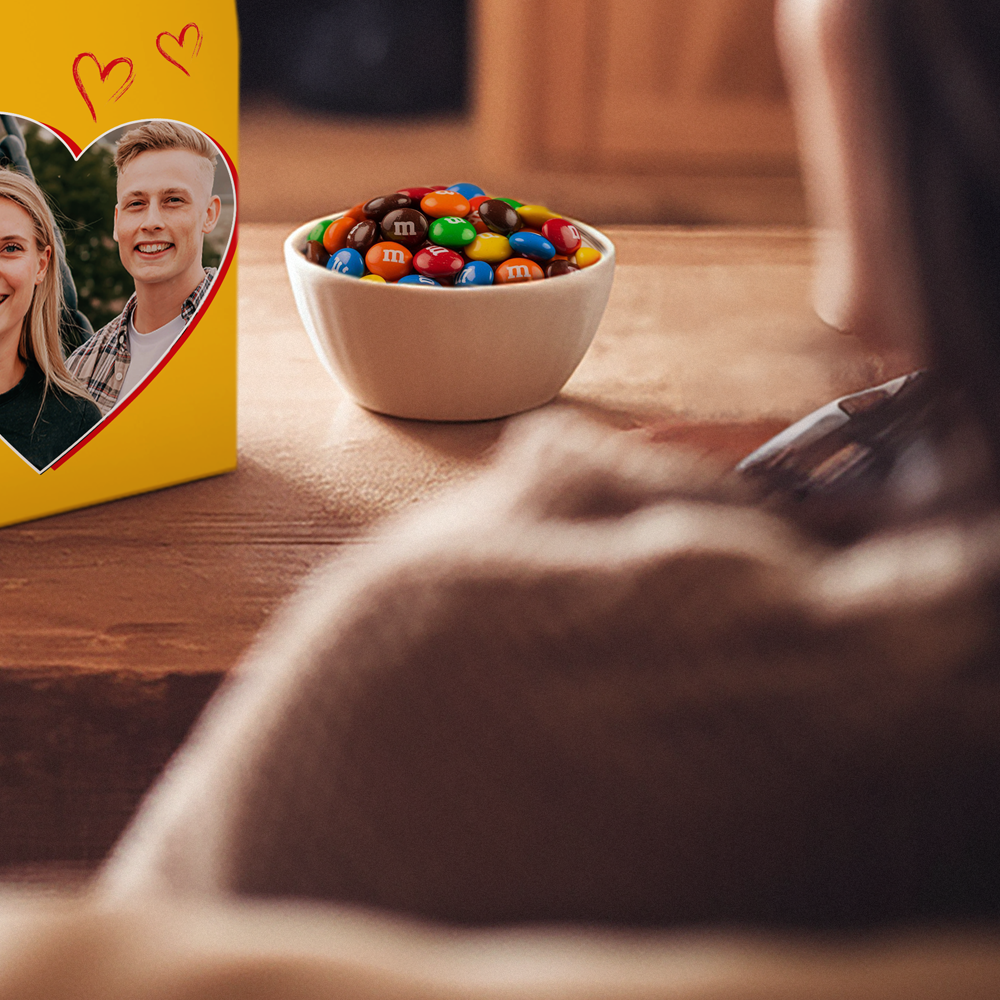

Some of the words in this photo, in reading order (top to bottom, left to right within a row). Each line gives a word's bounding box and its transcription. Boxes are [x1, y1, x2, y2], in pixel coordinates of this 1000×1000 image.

[393, 220, 417, 236] m
[382, 248, 406, 264] m
[506, 264, 532, 280] m
